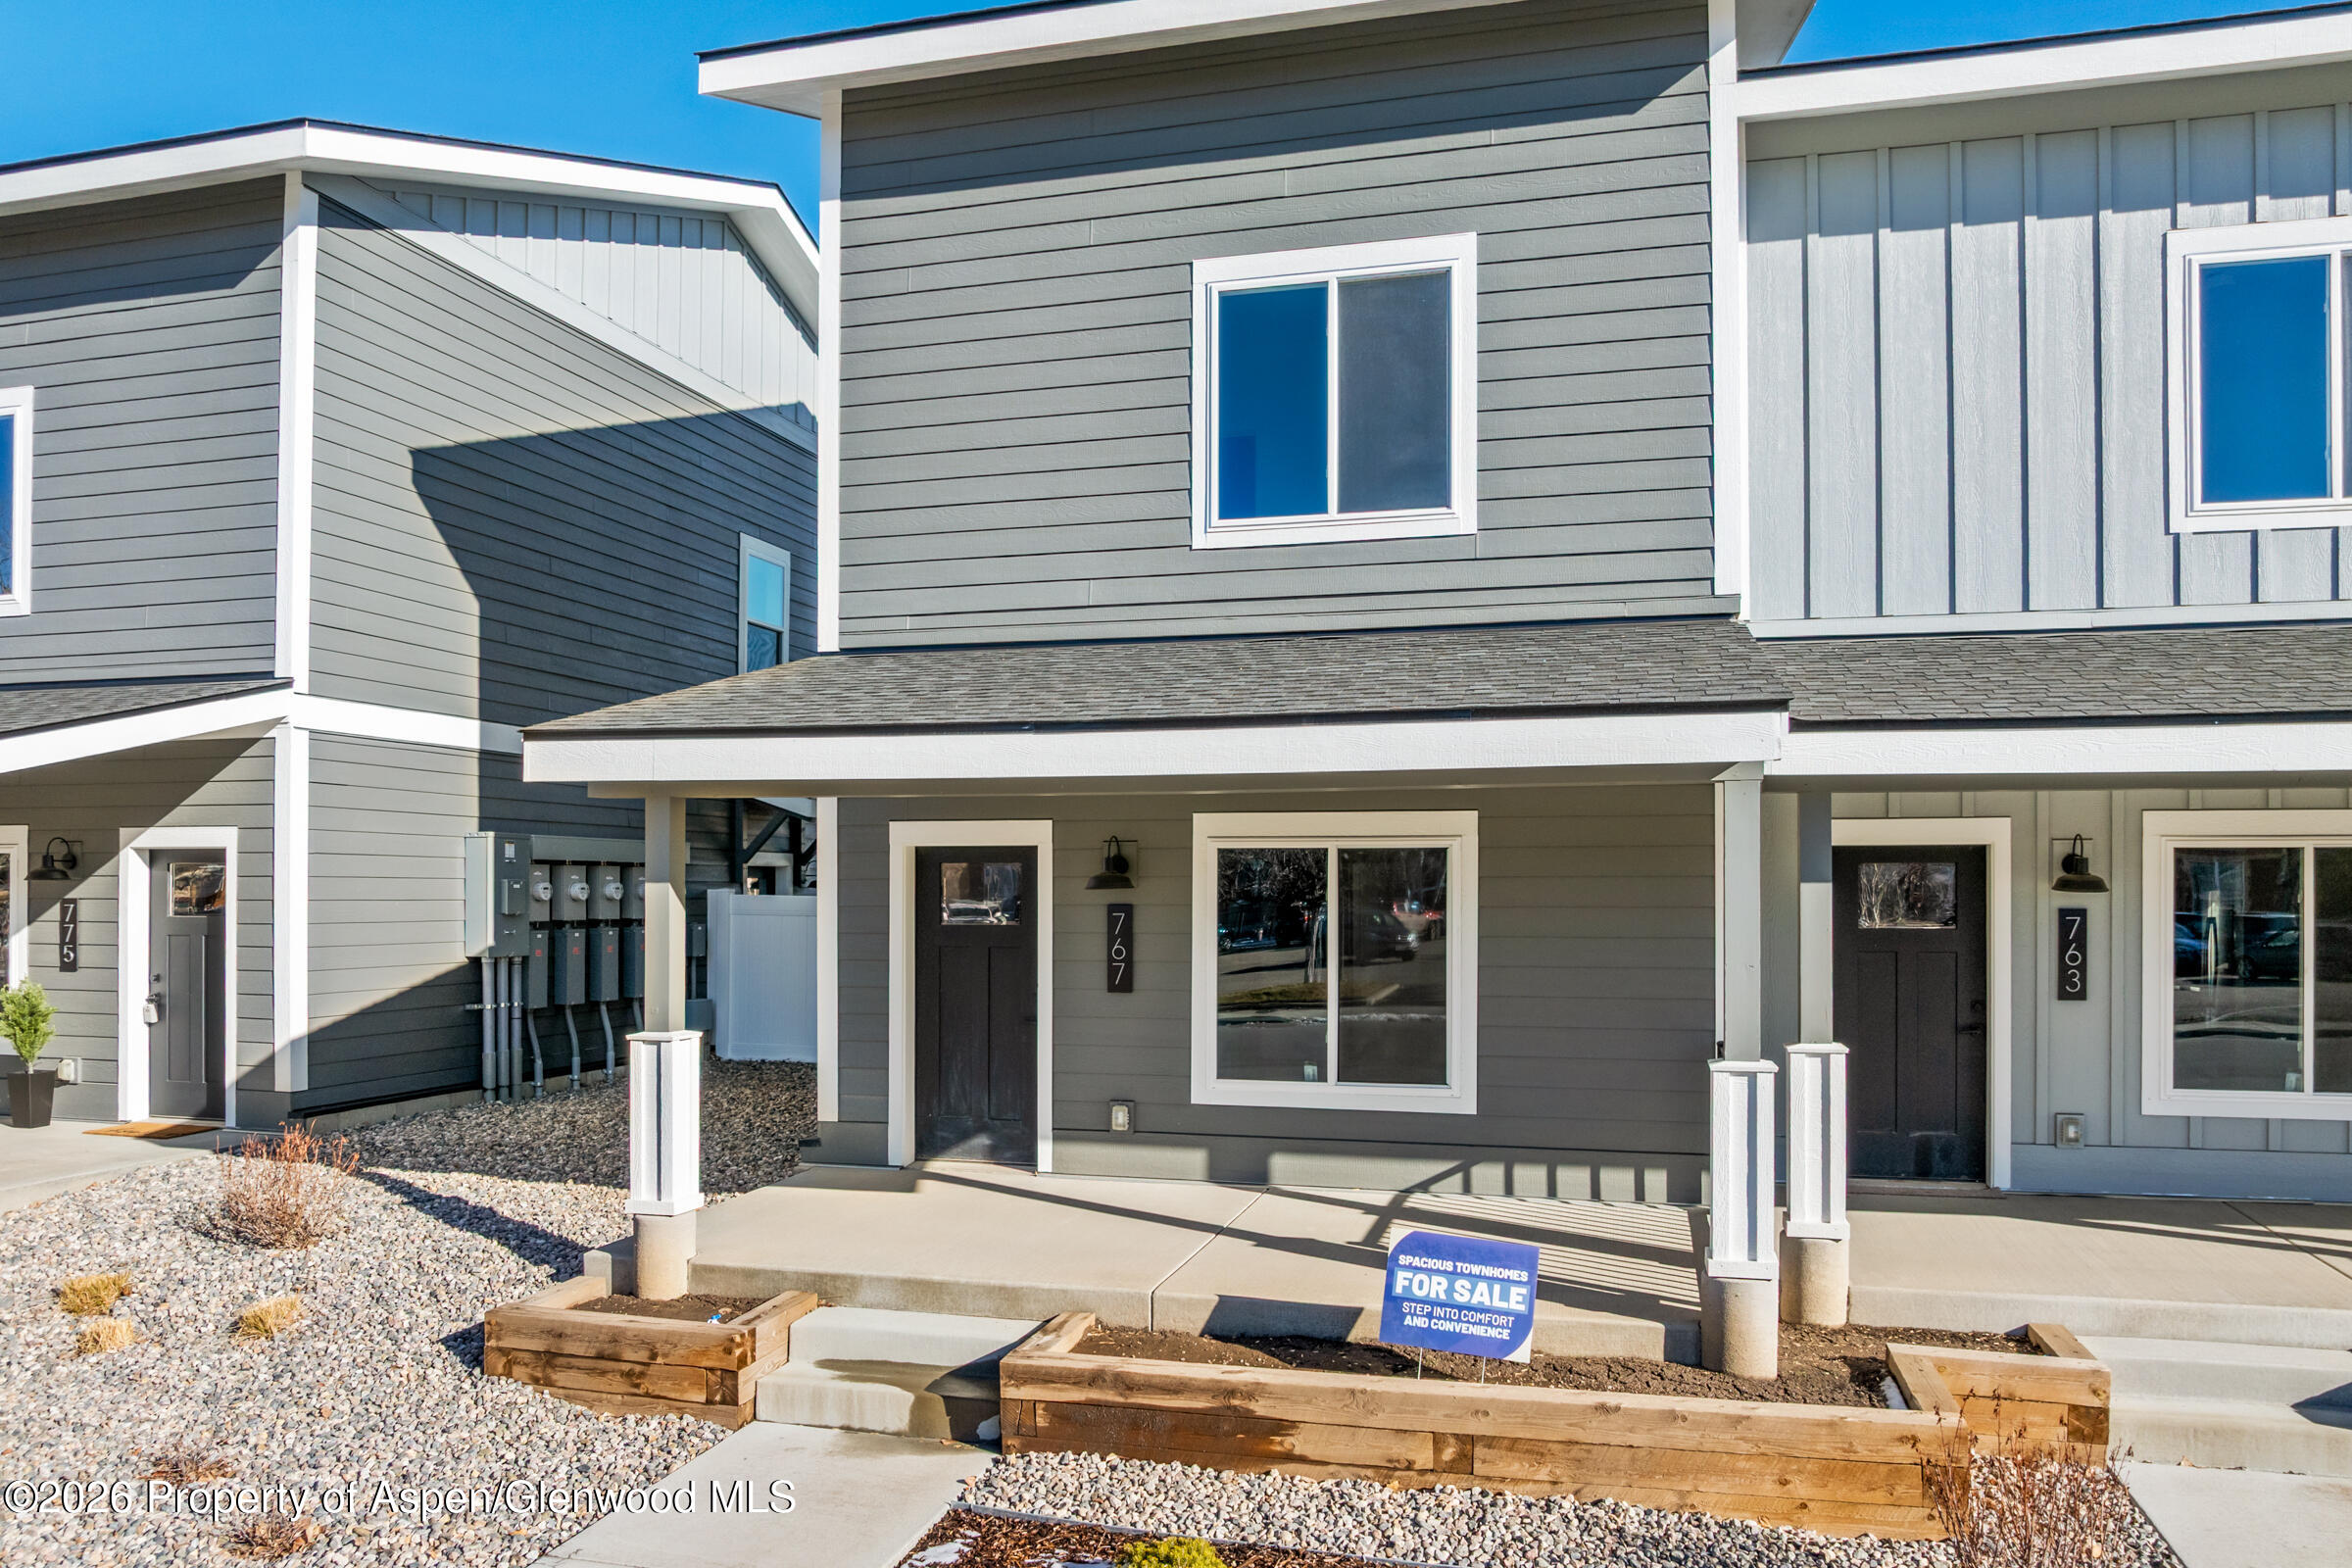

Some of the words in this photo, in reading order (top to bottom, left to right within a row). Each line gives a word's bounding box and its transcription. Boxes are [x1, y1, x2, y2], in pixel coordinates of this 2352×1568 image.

[63, 904, 74, 962] 775
[1112, 912, 1126, 985] 767
[2065, 916, 2082, 993] 763
[1398, 1254, 1453, 1272] SPACIOUS
[1455, 1262, 1529, 1282] TOWNHOMES
[1395, 1271, 1448, 1299] FOR
[1452, 1279, 1528, 1311] SALE
[1402, 1301, 1432, 1315] STEP
[1433, 1306, 1459, 1318] INTO
[1460, 1309, 1515, 1328] COMFORT
[1403, 1315, 1429, 1328] AND
[1431, 1320, 1510, 1340] CONVENIENCE
